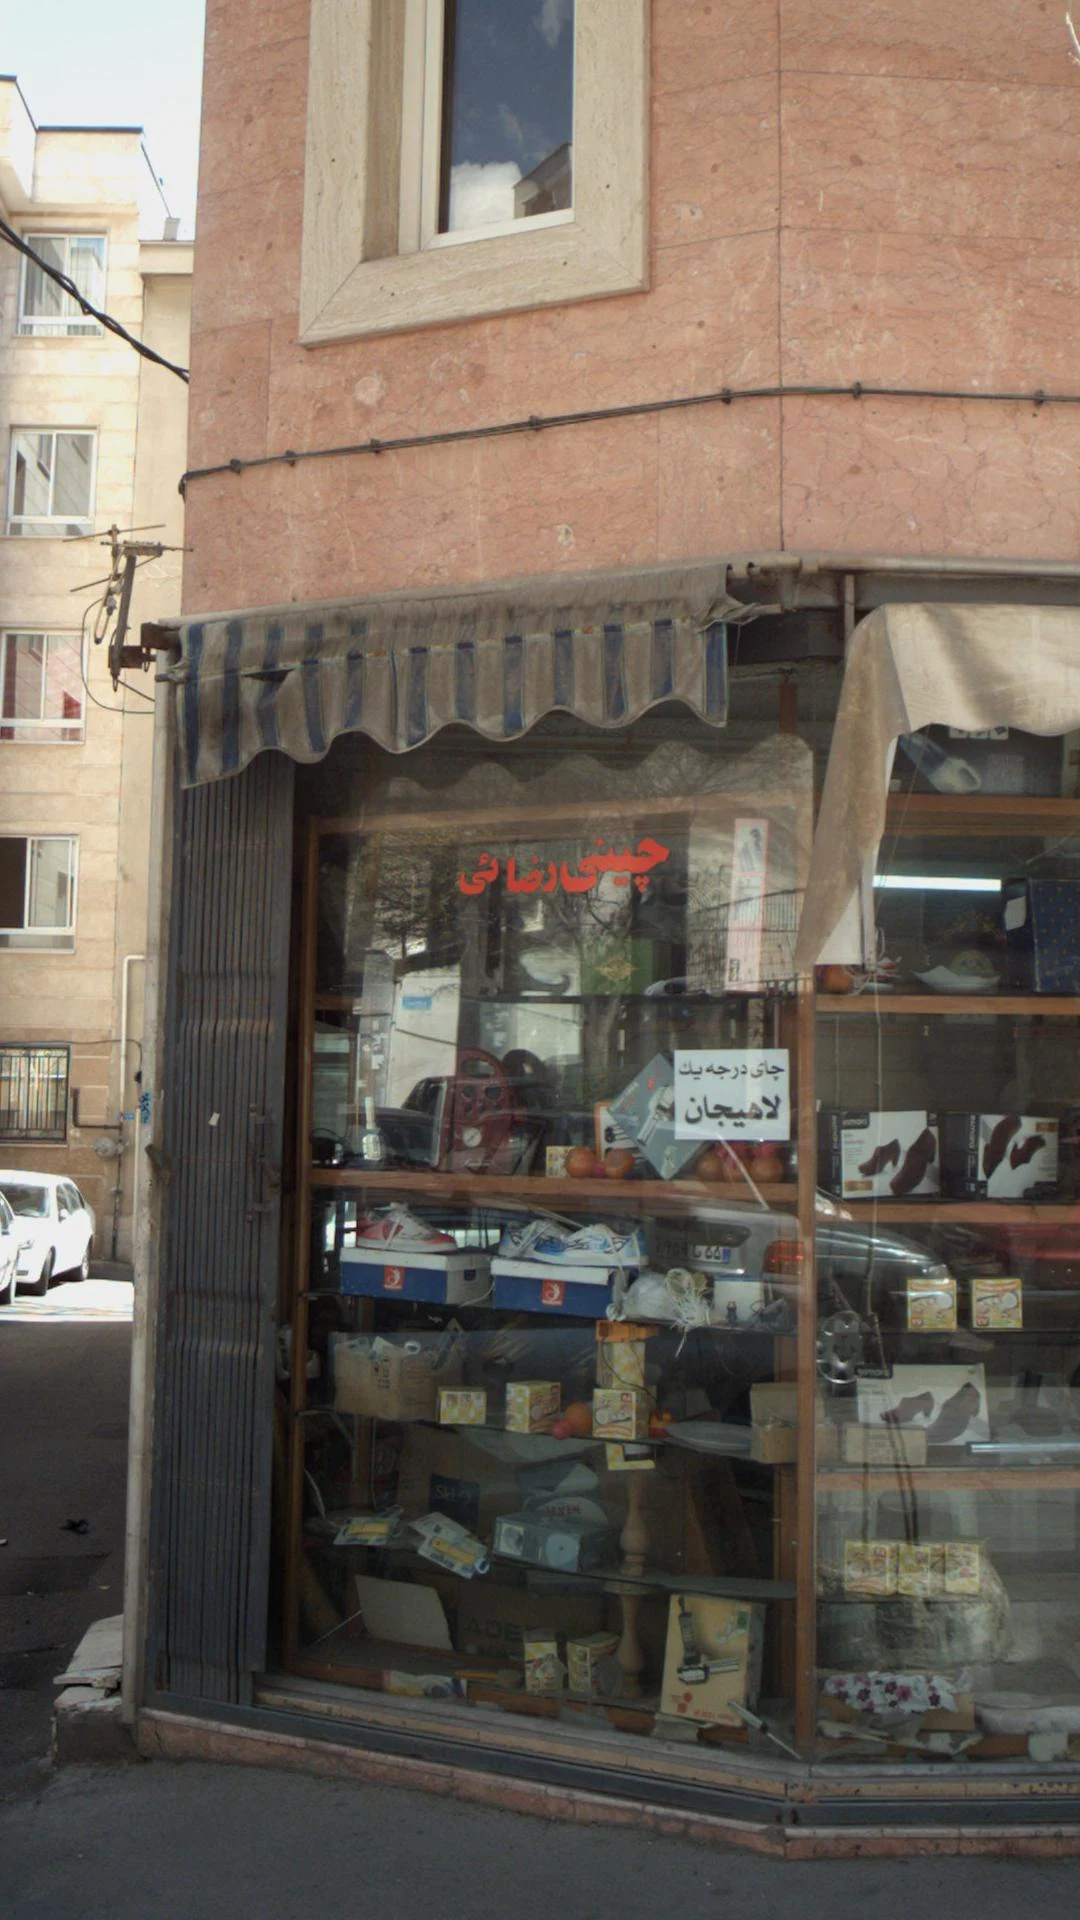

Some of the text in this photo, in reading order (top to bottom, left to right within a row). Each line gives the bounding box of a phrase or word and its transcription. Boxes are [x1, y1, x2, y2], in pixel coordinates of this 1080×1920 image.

[560, 838, 670, 893] چینی
[705, 1063, 748, 1080] درجه
[750, 1060, 785, 1081] چای
[685, 1094, 781, 1128] لاهیجان
